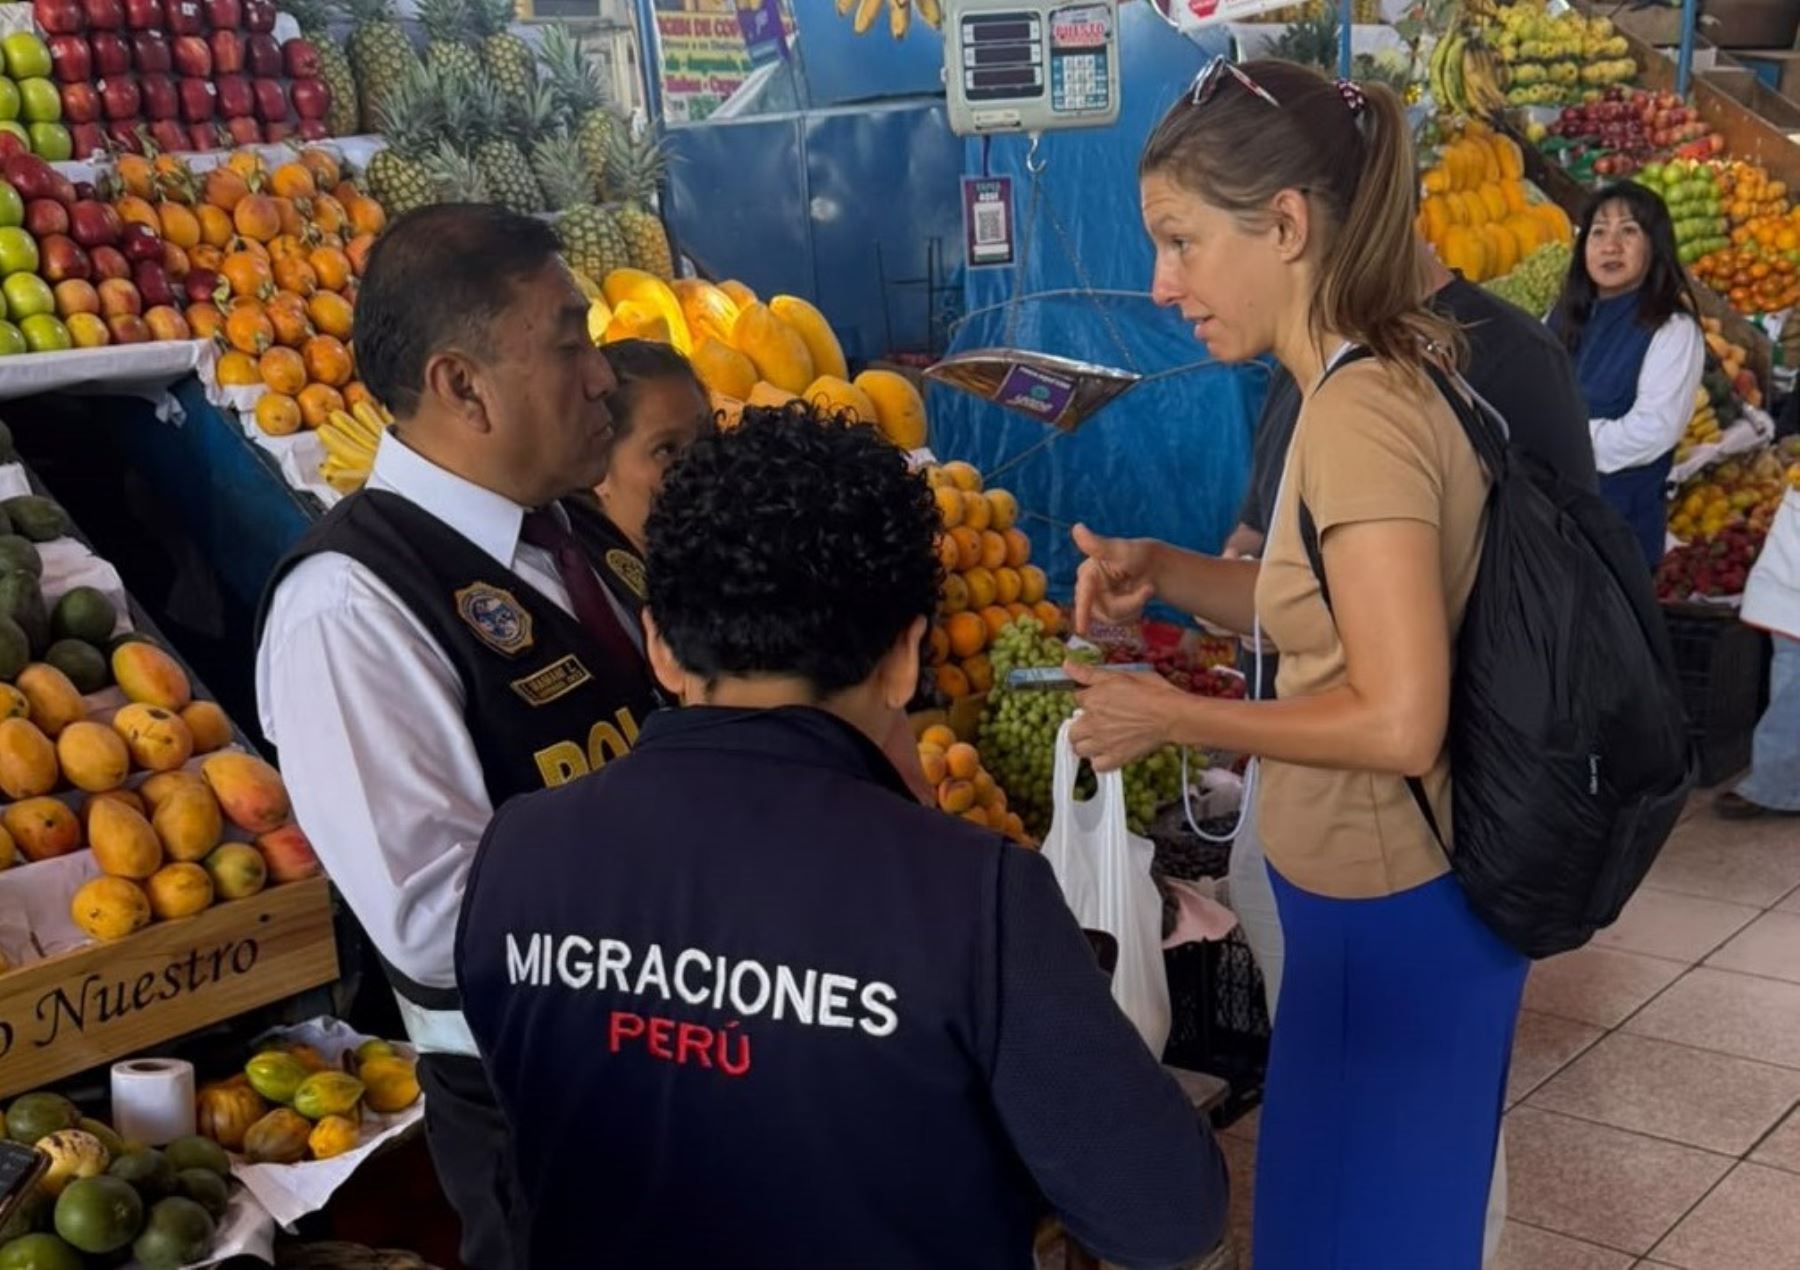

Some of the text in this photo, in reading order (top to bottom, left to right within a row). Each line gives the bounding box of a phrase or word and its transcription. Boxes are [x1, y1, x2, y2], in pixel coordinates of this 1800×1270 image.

[35, 937, 259, 1047] Nuestro
[506, 932, 898, 1037] MIGRACIONES
[608, 1011, 751, 1076] PERÚ
